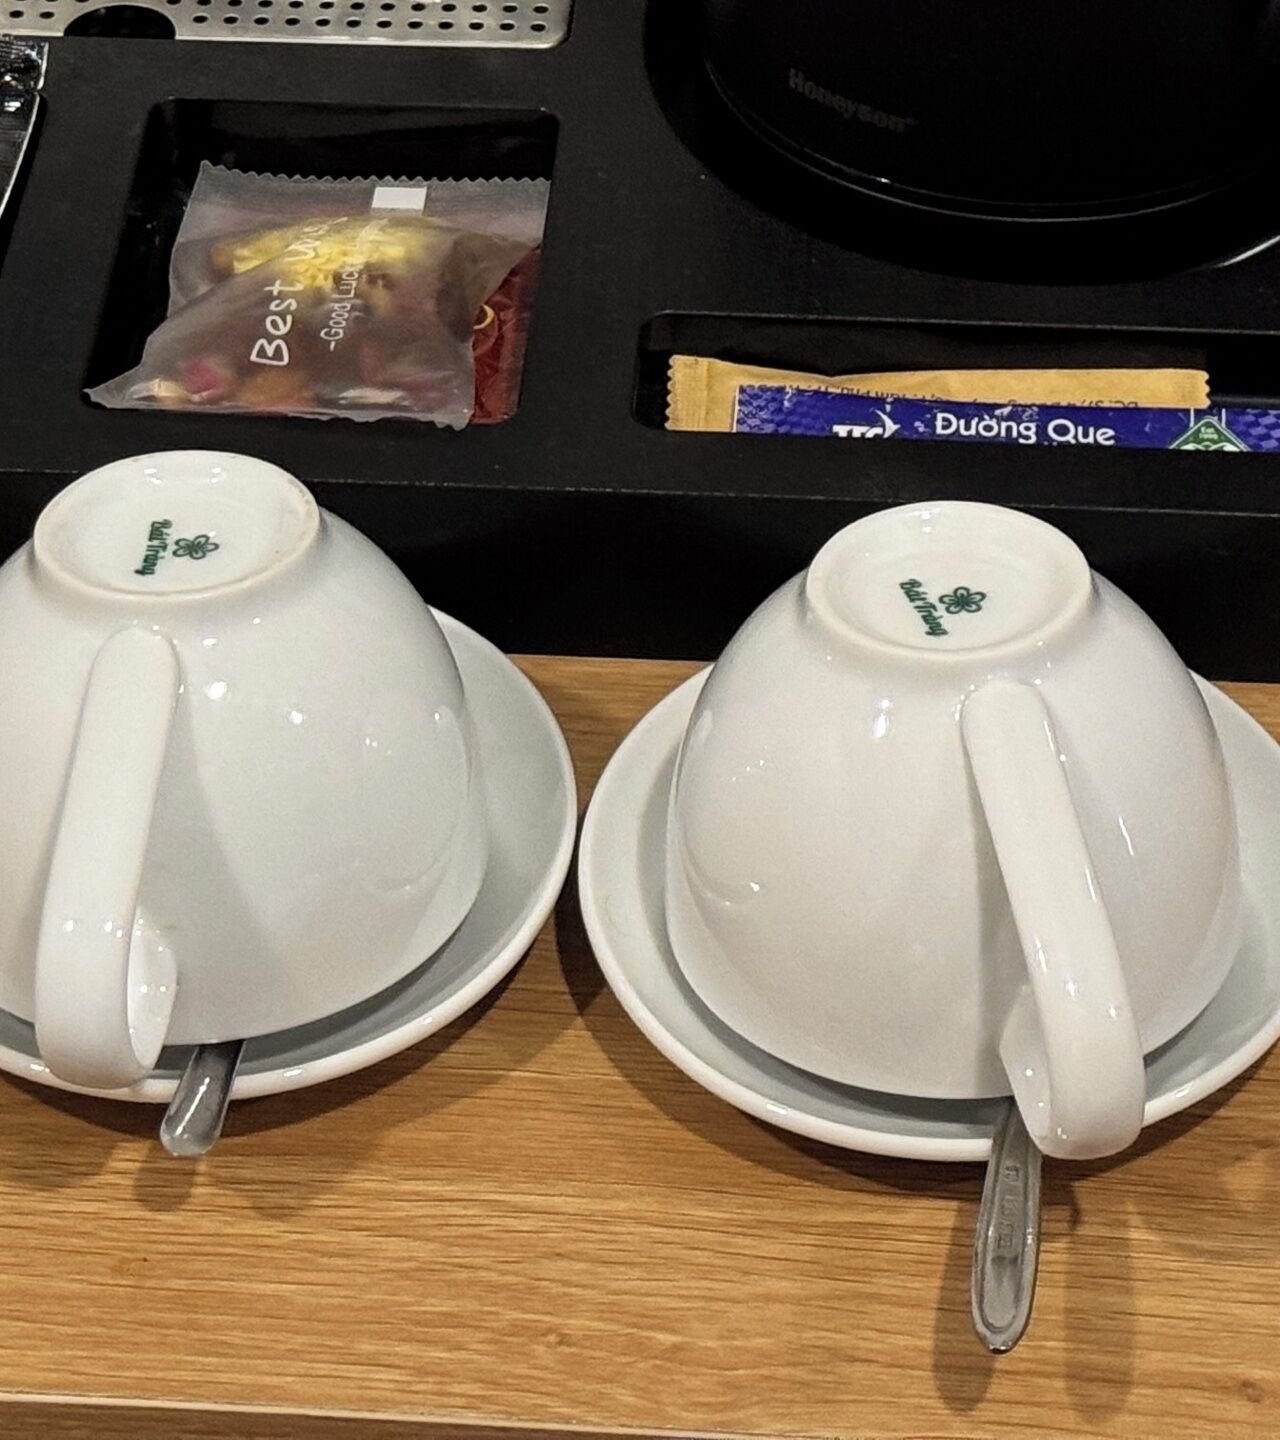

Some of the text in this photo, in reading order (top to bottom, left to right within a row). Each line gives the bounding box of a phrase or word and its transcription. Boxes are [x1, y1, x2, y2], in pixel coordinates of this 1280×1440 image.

[249, 279, 305, 367] Best
[935, 413, 1117, 446] Đường Que
